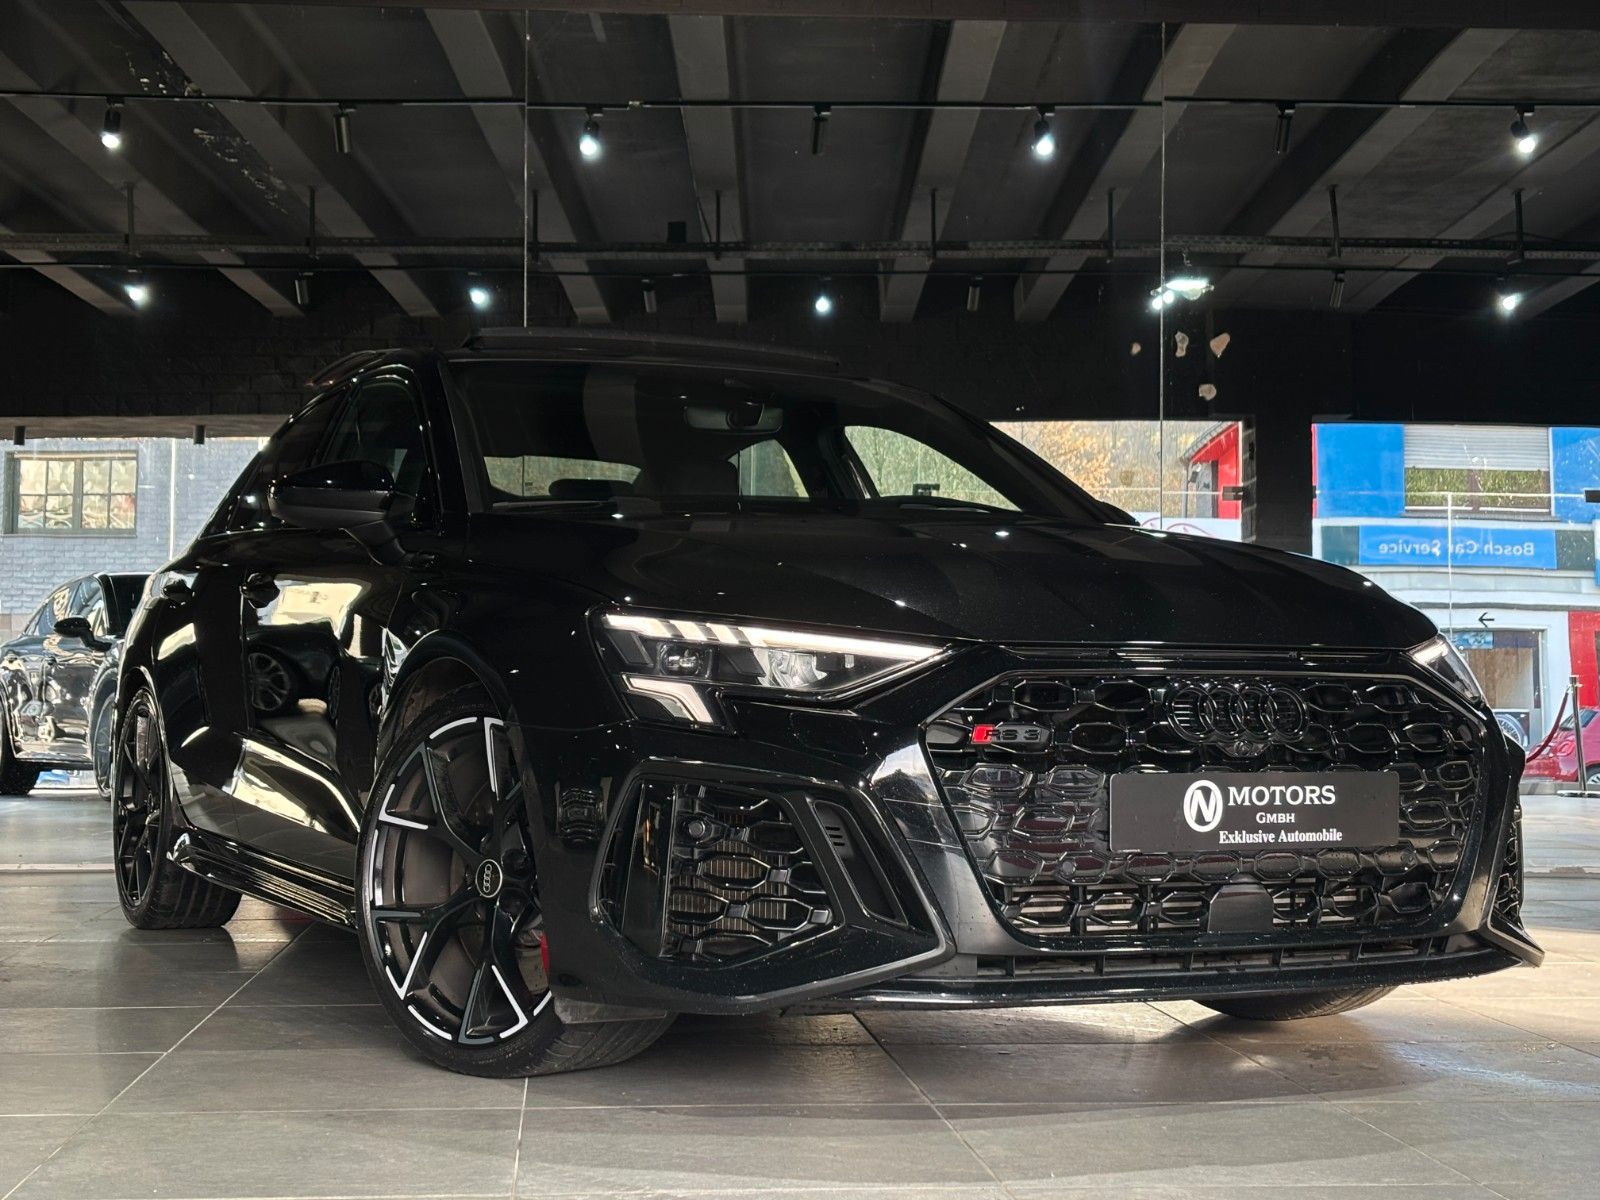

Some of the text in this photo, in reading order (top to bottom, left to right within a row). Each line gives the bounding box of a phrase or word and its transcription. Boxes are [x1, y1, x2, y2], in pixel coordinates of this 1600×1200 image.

[1228, 785, 1336, 806] MOTORS
[1256, 812, 1296, 824] GMBH
[1219, 828, 1343, 844] Exklusive Automobile
